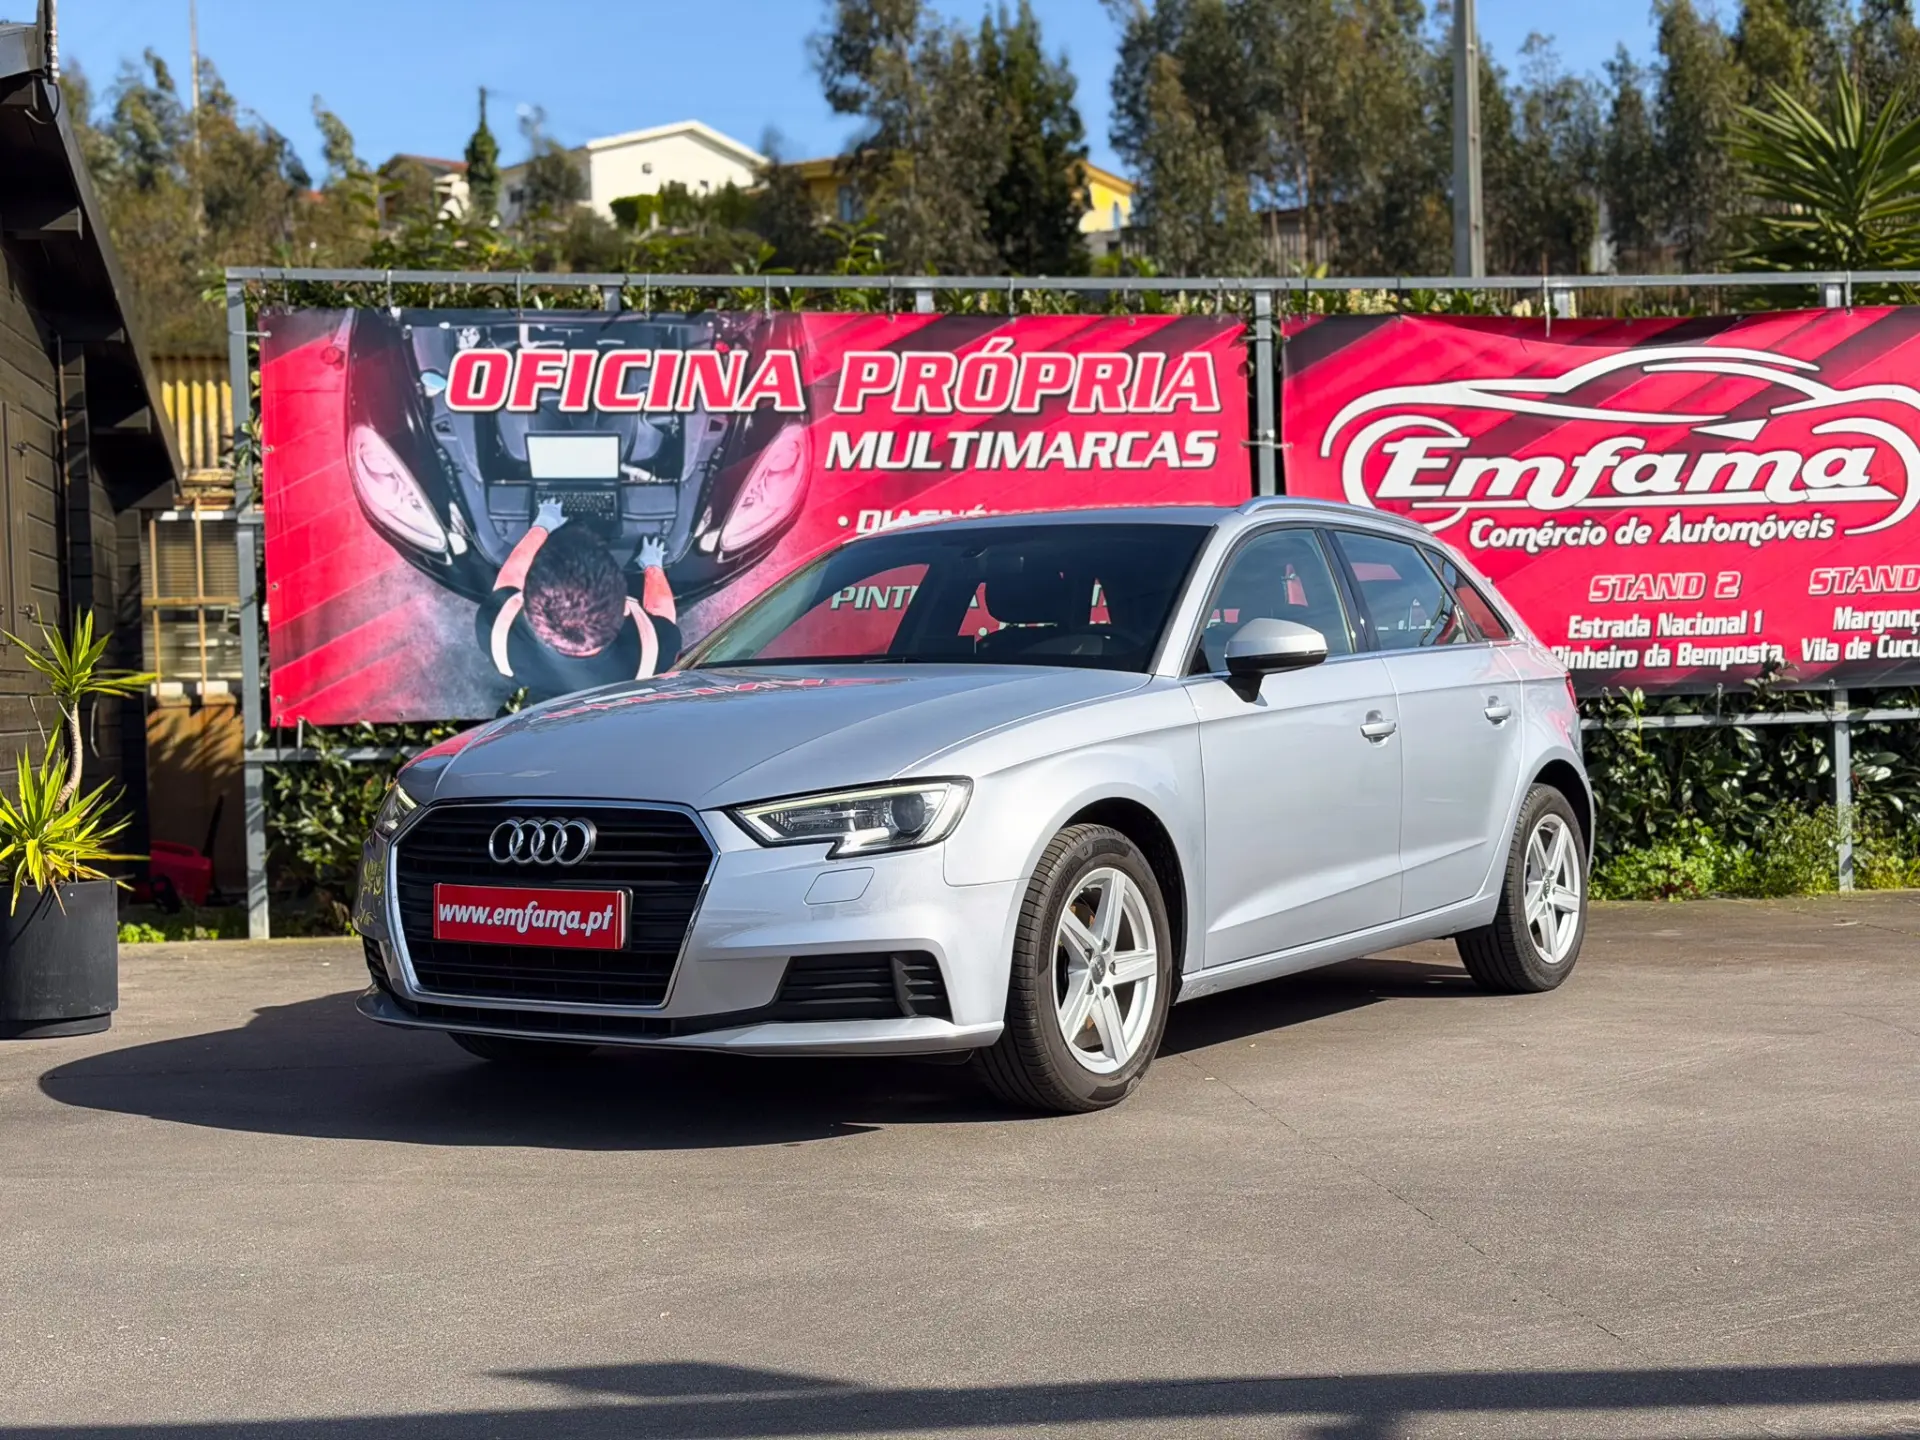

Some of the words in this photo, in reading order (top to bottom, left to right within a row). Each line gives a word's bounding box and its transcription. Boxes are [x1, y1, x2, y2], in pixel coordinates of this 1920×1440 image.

[446, 348, 806, 412] OFICINA
[834, 337, 1221, 413] PRÓPRIA
[825, 431, 1220, 469] MULTIMARCAS
[1376, 437, 1876, 509] Emfama
[1469, 516, 1603, 553] Comércio
[1615, 514, 1650, 545] de
[1660, 513, 1835, 549] Automóveis
[1588, 573, 1706, 602] STAND
[1714, 571, 1741, 599] 2
[1808, 564, 1920, 595] STAND
[1567, 613, 1651, 639] Estrada
[1656, 610, 1747, 637] Nacional
[1754, 609, 1763, 634] 1
[1643, 643, 1670, 668] da
[1676, 641, 1784, 671] Bemposta
[1801, 637, 1840, 662] Vila
[1844, 636, 1872, 660] de
[439, 901, 613, 937] www.emfama.pt
